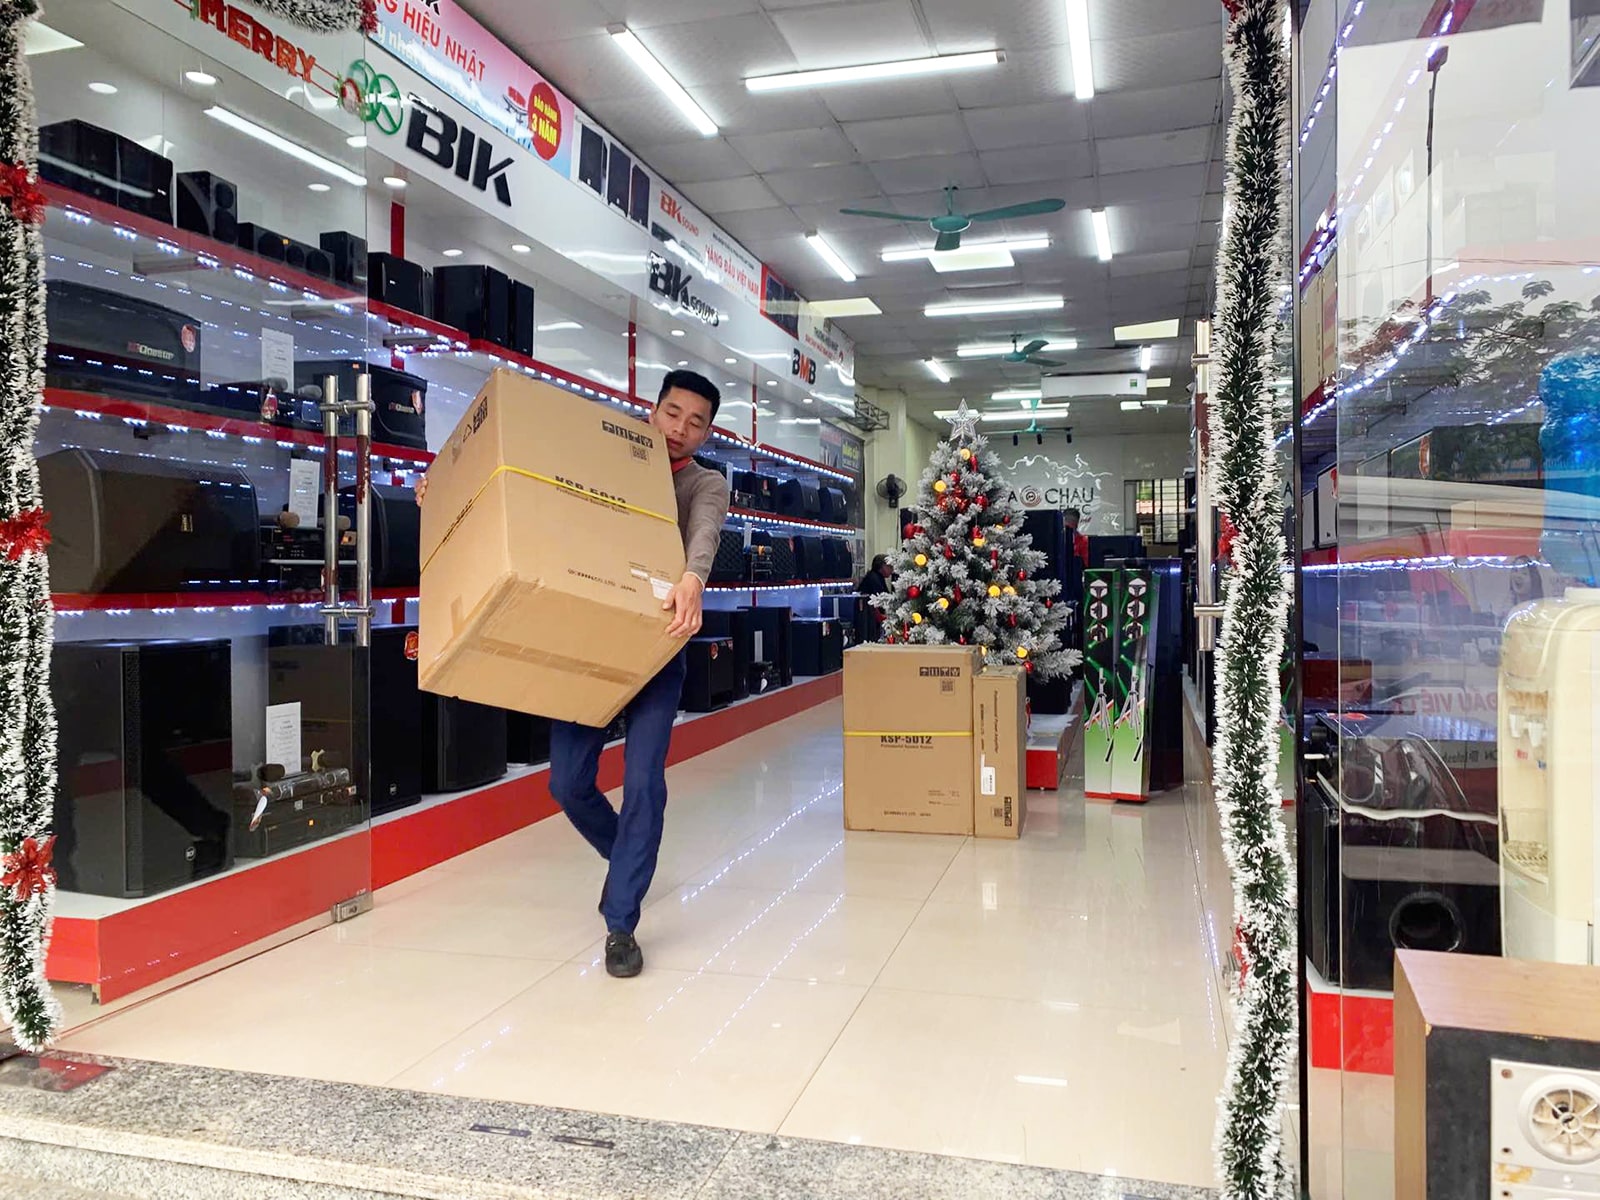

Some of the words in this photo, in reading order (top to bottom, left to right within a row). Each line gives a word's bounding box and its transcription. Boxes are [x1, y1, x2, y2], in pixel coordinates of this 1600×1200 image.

[199, 0, 316, 83] MERRY
[402, 2, 441, 48] HIỆU
[445, 35, 486, 81] NHẬT
[406, 93, 515, 207] BIK
[531, 112, 538, 132] 3
[538, 118, 557, 147] NĂM
[791, 347, 816, 385] BMB
[880, 734, 932, 745] KSP-5012
